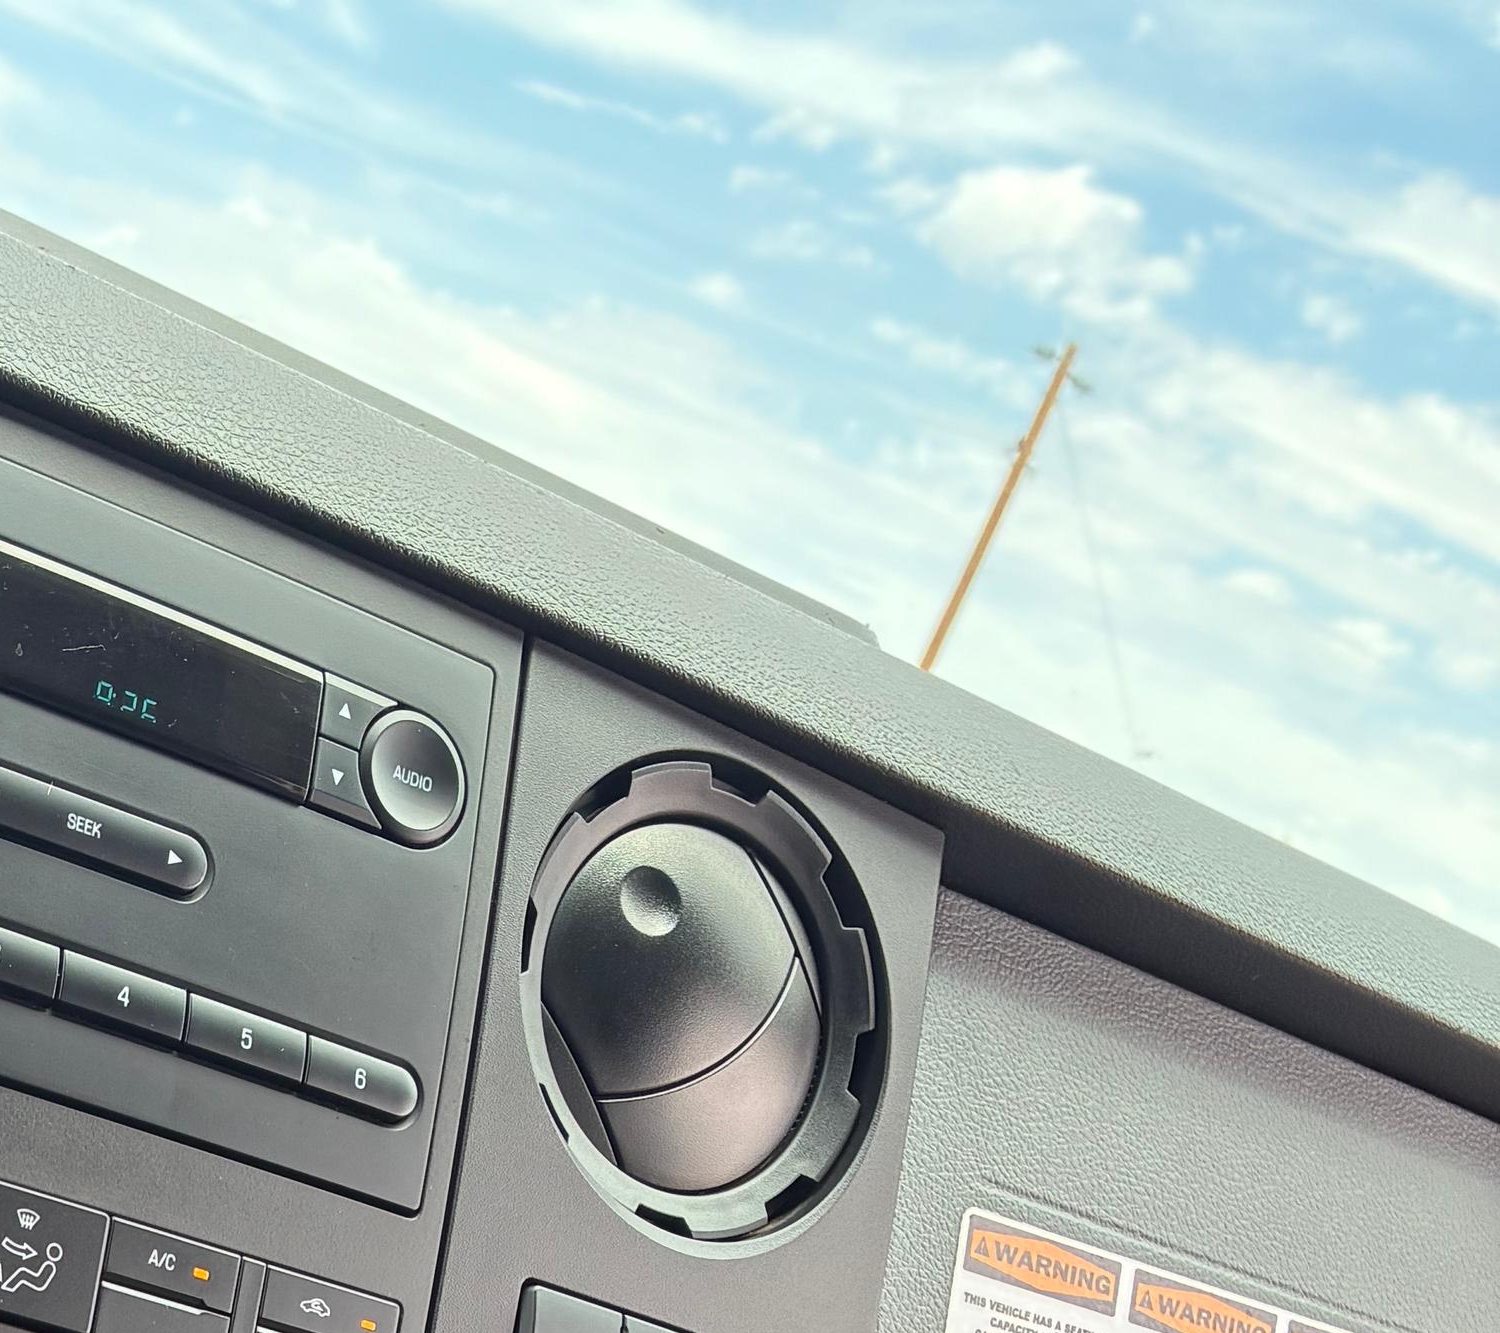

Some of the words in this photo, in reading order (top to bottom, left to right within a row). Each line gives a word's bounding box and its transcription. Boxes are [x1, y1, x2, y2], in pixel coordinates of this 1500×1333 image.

[392, 764, 434, 793] AUDIO
[66, 813, 103, 839] SEEK
[116, 985, 131, 1008] 4
[240, 1027, 254, 1050] 5
[353, 1067, 367, 1090] 6
[147, 1248, 177, 1272] A/C
[994, 1239, 1112, 1297] WARNING
[964, 1291, 987, 1308] THIS
[989, 1299, 1031, 1322] VEHICLE
[1033, 1313, 1053, 1329] HAS
[1054, 1320, 1063, 1331] A
